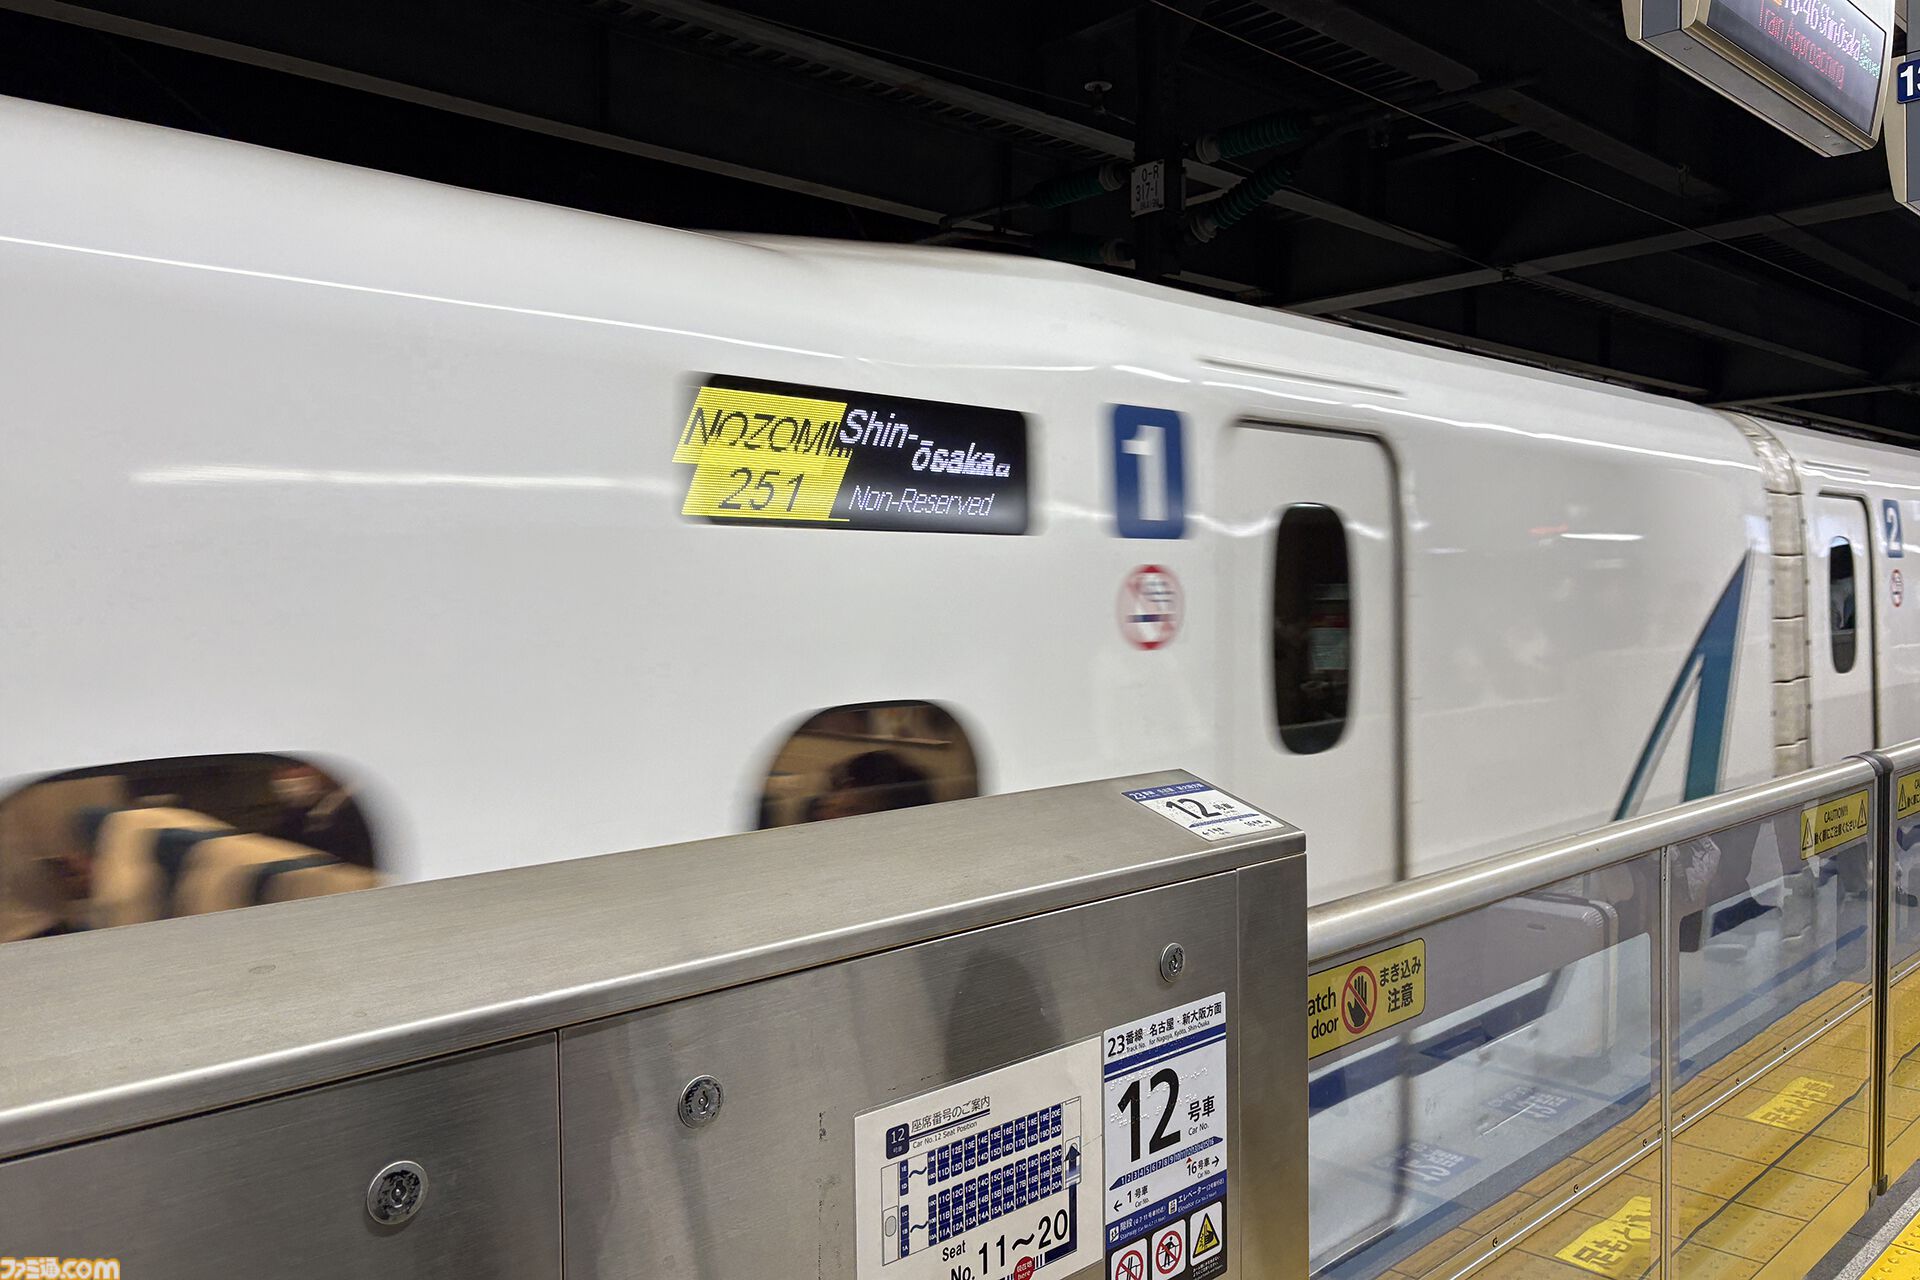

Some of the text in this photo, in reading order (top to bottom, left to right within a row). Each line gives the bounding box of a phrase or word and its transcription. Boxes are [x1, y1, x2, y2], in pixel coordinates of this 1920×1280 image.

[683, 407, 842, 456] NOZOMI
[719, 467, 805, 512] 251
[1121, 424, 1169, 521] 1
[849, 485, 995, 516] Non-Reserved
[1886, 507, 1901, 550] 2
[1166, 798, 1222, 819] 12
[1380, 956, 1421, 987] まき込み
[1308, 986, 1336, 1016] atch
[1387, 983, 1413, 1013] 注意
[1311, 1017, 1338, 1039] door
[911, 1095, 990, 1133] 座席番号のご案内
[1117, 1068, 1215, 1162] 12 号車
[891, 1128, 905, 1145] 12
[912, 1140, 923, 1149] Car
[938, 1150, 949, 1159] 11E
[952, 1145, 962, 1155] 12E
[966, 1141, 975, 1150] 13E
[978, 1136, 988, 1145] 14E
[990, 1131, 1000, 1140] 15E
[1004, 1127, 1013, 1136] 16E
[1016, 1122, 1025, 1131] 17E
[938, 1168, 950, 1177] 11D
[952, 1162, 962, 1172] 12D
[966, 1158, 976, 1166] 13D
[978, 1152, 988, 1162] 14D
[990, 1148, 1001, 1157] 15D
[1004, 1143, 1014, 1152] 16D
[1016, 1138, 1026, 1147] 17D
[940, 1194, 950, 1204] 11C
[953, 1189, 963, 1198] 12C
[966, 1184, 976, 1194] 13C
[979, 1178, 989, 1188] 14C
[992, 1173, 1002, 1182] 15C
[1004, 1168, 1014, 1178] 16C
[1016, 1164, 1026, 1173] 17C
[940, 1228, 951, 1238] 11A
[953, 1222, 964, 1232] 12A
[966, 1216, 977, 1226] 13A
[979, 1211, 989, 1220] 14A
[992, 1205, 1002, 1215] 15A
[1004, 1200, 1015, 1210] 16A
[1016, 1195, 1027, 1205] 17A
[942, 1240, 966, 1262] Seat
[951, 1265, 975, 1280] No.
